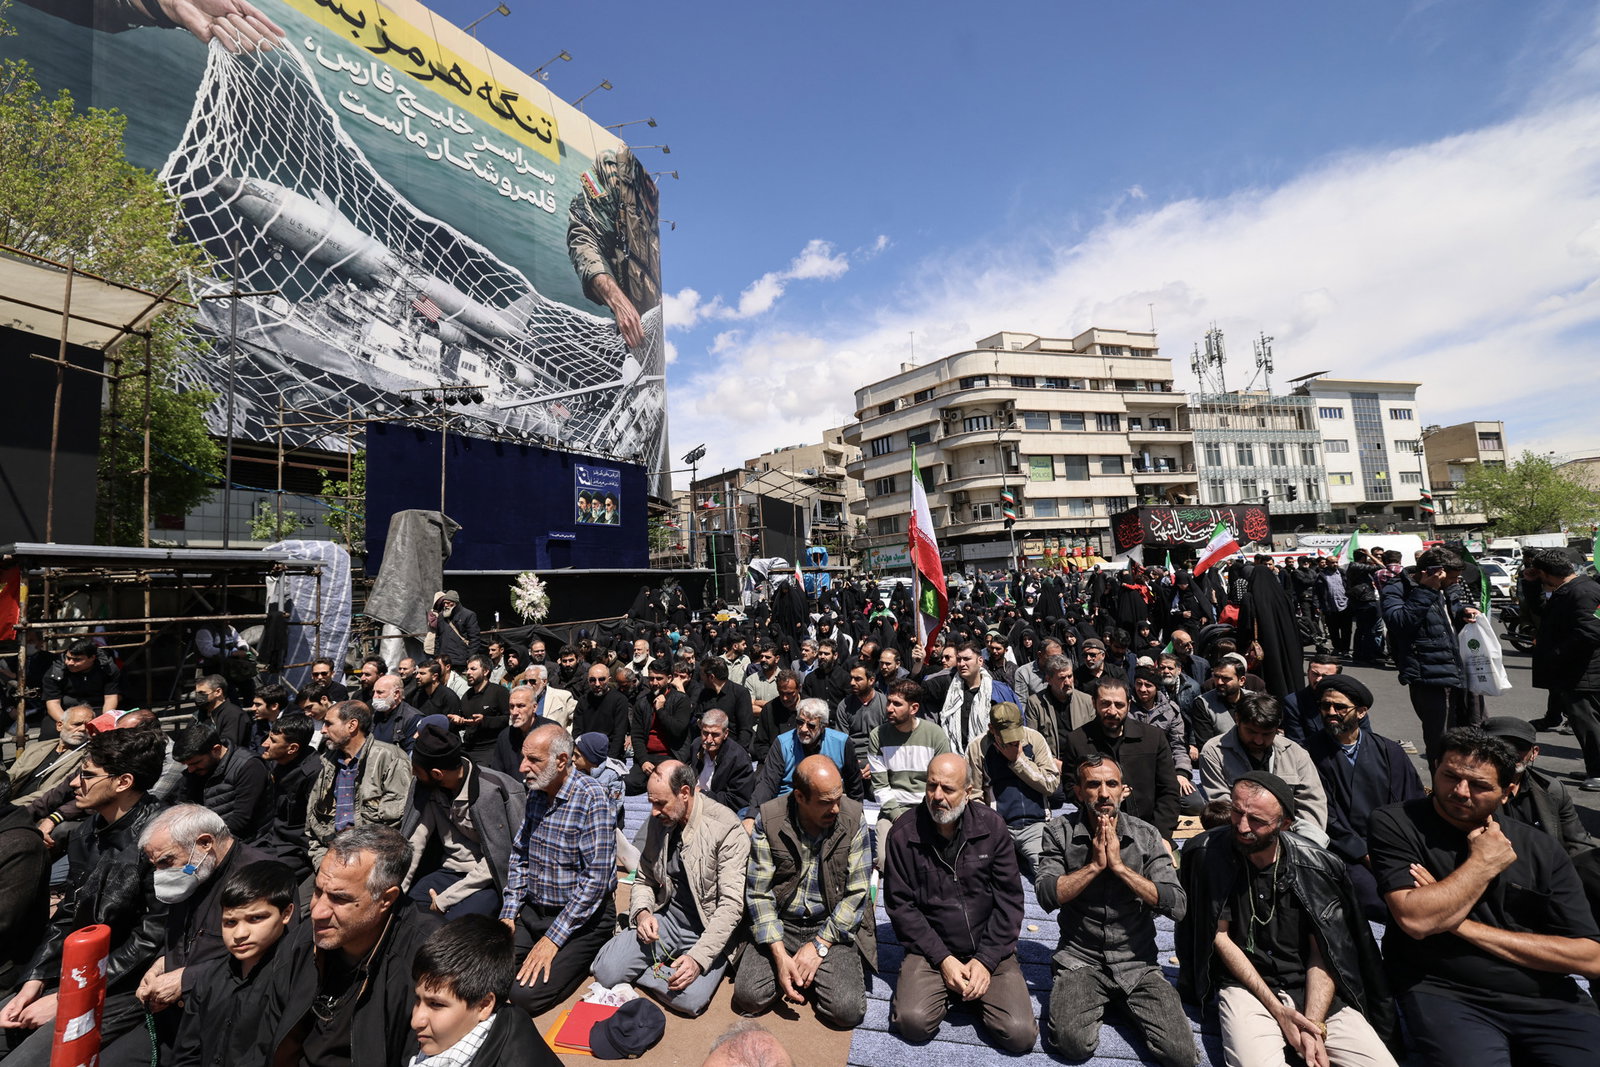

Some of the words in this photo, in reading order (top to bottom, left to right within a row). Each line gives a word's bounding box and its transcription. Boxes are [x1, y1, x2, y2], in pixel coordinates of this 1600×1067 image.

[365, 18, 473, 96] هرمز
[396, 85, 474, 136] خلیج
[477, 81, 553, 144] تنگه
[426, 138, 498, 184] شکار
[473, 136, 556, 186] سراسر
[497, 177, 557, 214] قلمرو
[306, 228, 319, 238] AIR
